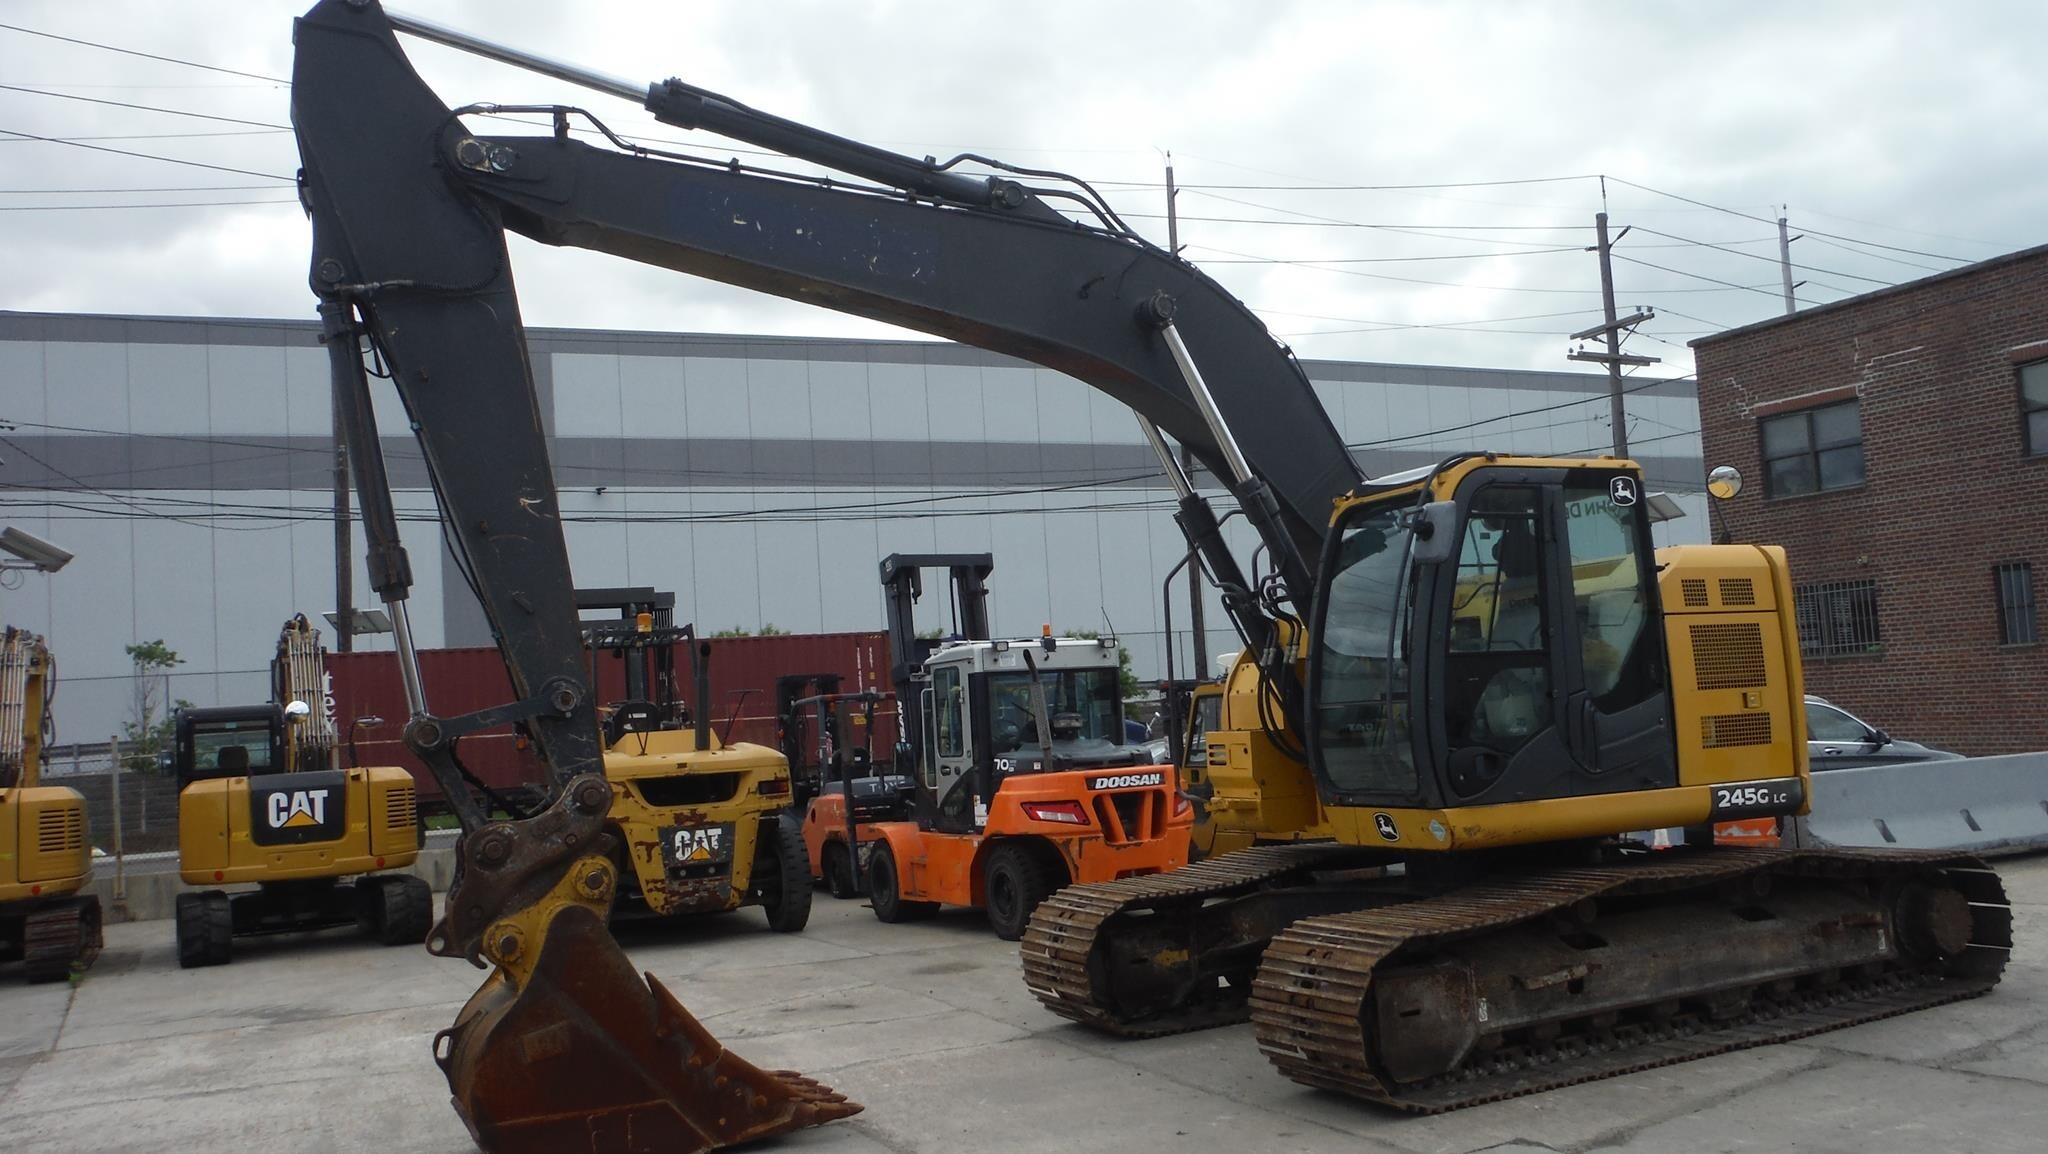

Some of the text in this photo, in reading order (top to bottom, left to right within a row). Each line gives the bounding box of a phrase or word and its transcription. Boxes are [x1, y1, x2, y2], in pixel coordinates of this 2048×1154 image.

[993, 758, 1010, 771] 70
[1095, 773, 1160, 790] DOOSAN
[1717, 787, 1787, 808] 245G LC
[268, 789, 329, 829] CAT
[674, 827, 722, 861] CAT
